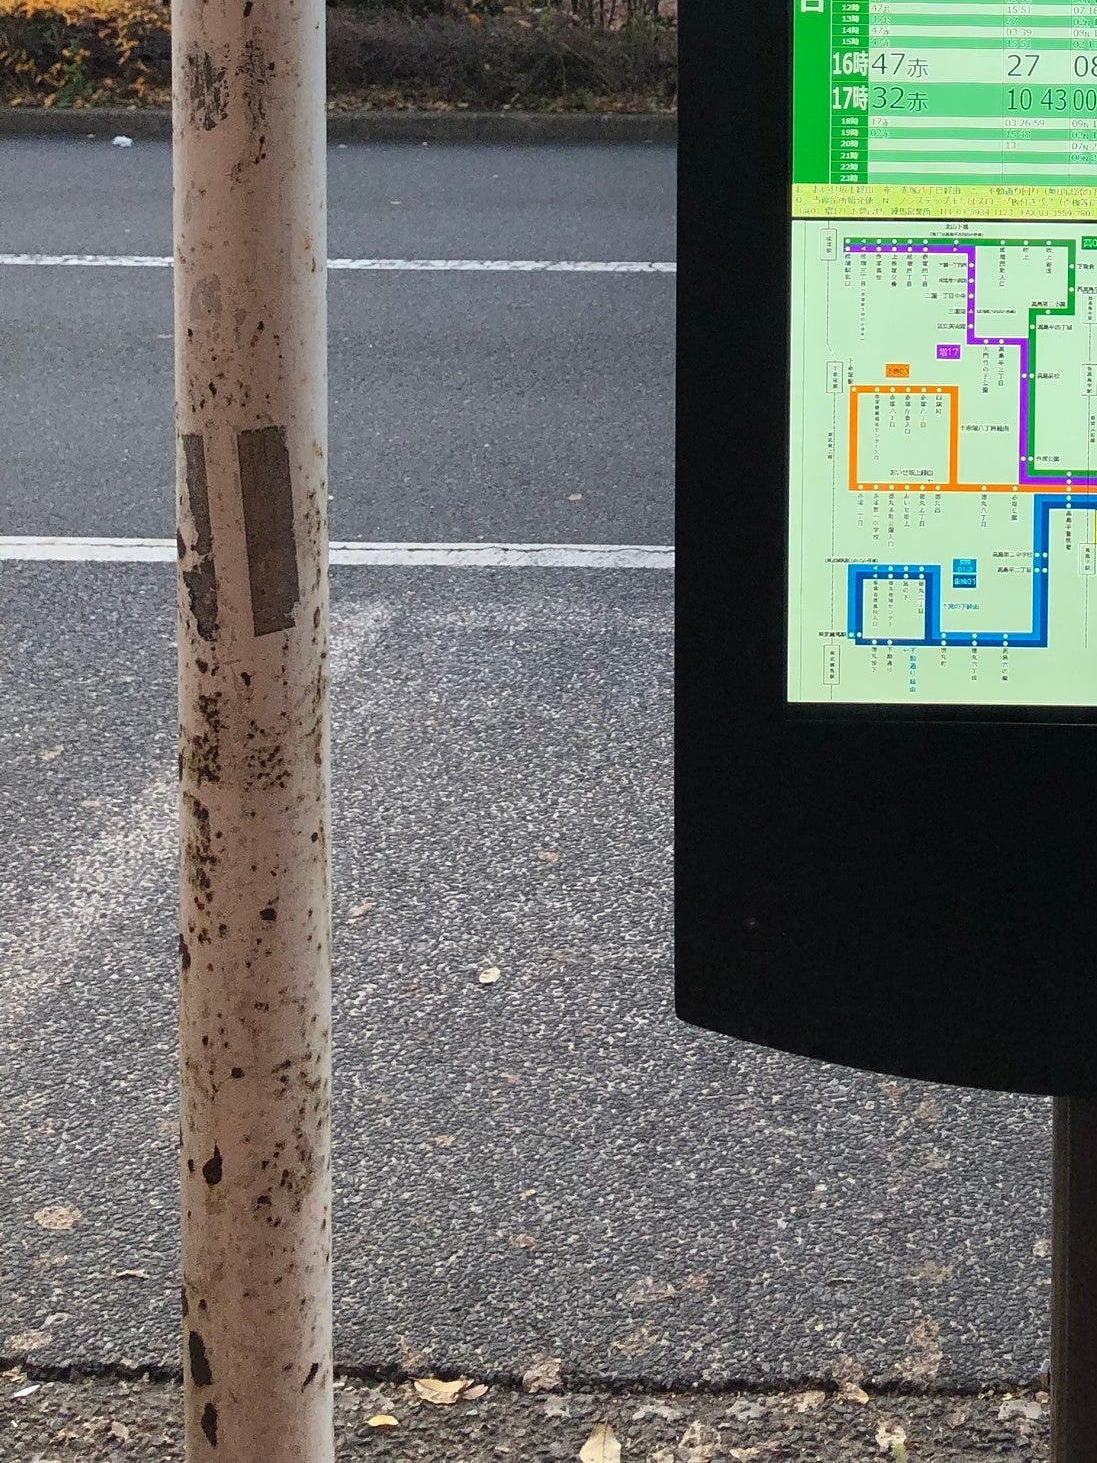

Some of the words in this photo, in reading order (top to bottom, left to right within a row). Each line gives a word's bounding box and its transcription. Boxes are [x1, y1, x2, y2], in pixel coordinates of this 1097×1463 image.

[833, 51, 869, 76] 16時
[871, 52, 929, 78] 47赤
[1007, 54, 1040, 77] 27
[833, 85, 869, 111] 17時
[871, 87, 929, 112] 32赤
[1007, 88, 1033, 111] 10
[1040, 88, 1067, 111] 43
